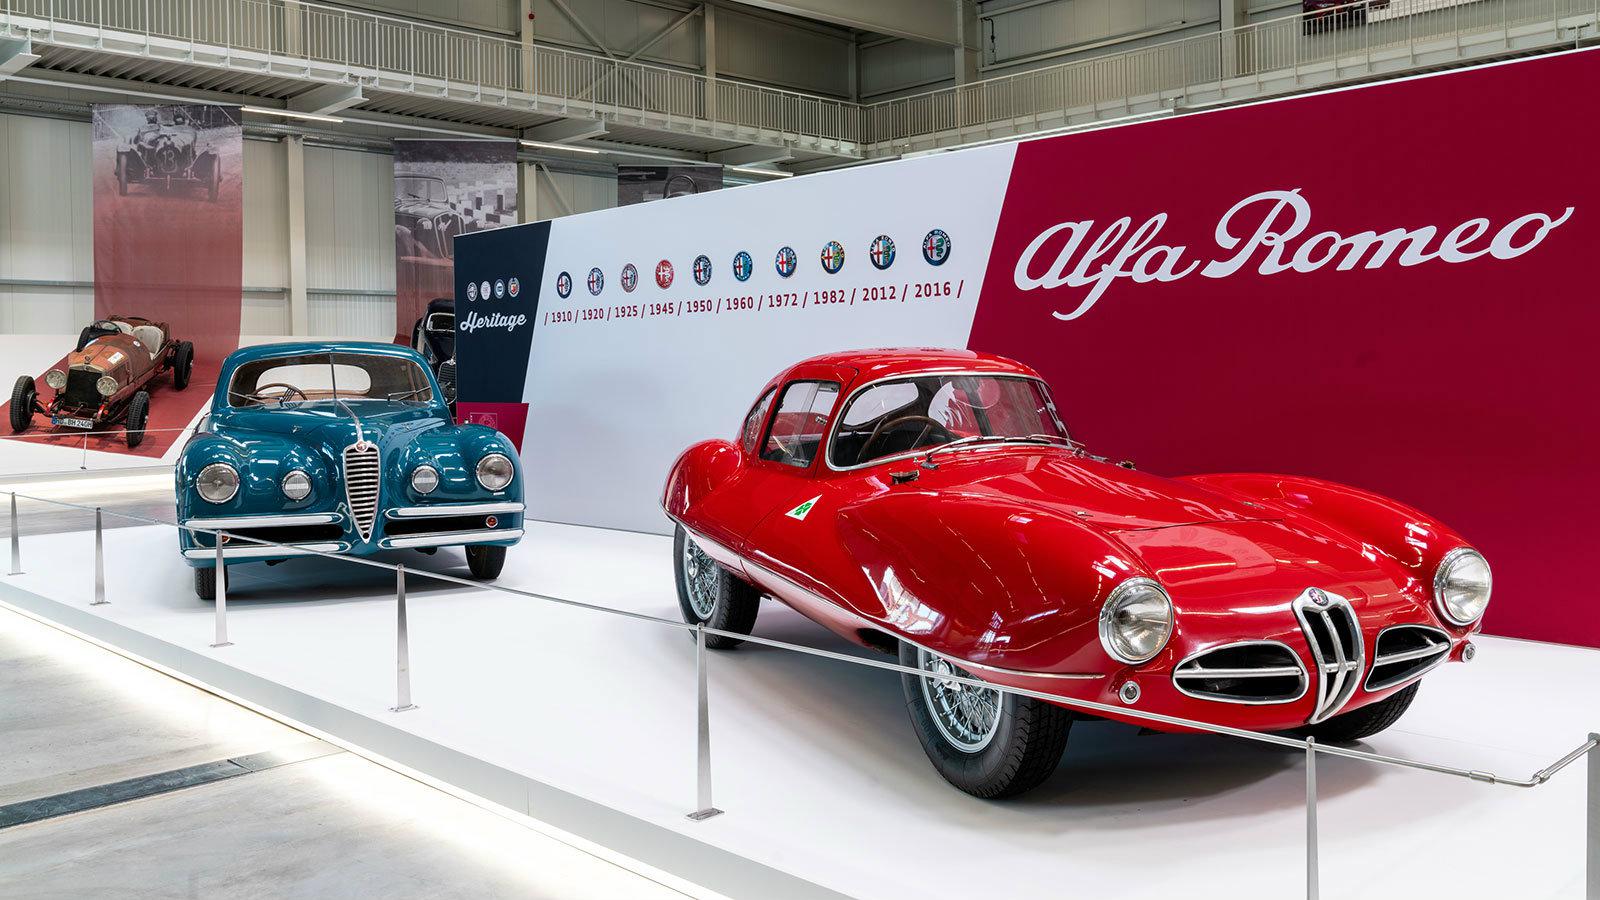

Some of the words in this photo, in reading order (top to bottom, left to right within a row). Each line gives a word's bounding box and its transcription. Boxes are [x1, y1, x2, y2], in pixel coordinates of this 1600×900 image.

[1013, 212, 1201, 321] Alfa
[1199, 187, 1575, 279] Romeo
[459, 310, 527, 334] Heritage
[551, 311, 573, 323] 1910
[582, 308, 604, 321] 1920
[615, 305, 638, 318] 1925
[650, 302, 674, 316] 1945
[686, 299, 713, 313] 1950
[726, 296, 754, 311] 1960
[768, 293, 798, 308] 1972
[813, 289, 846, 305] 1982
[862, 285, 897, 302] 2012
[914, 281, 951, 299] 2016
